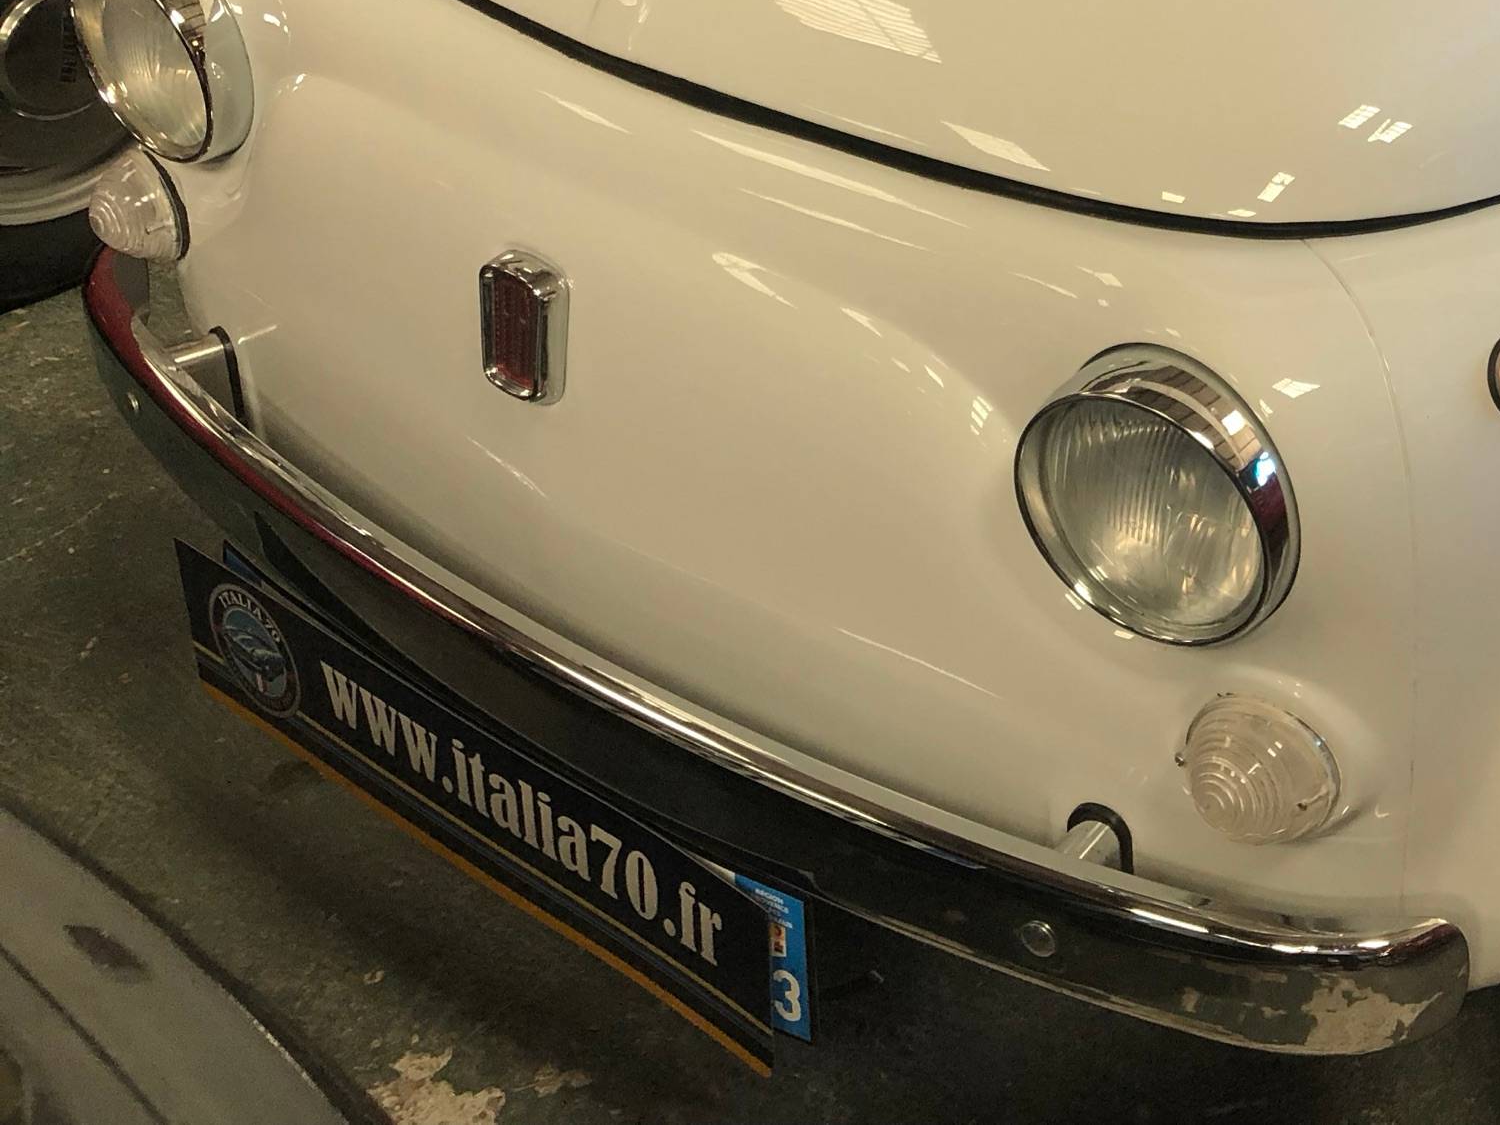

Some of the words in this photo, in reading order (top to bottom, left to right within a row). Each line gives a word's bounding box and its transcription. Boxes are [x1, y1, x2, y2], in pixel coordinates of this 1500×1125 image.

[218, 590, 264, 622] ITALIA
[263, 617, 282, 644] 70
[320, 659, 723, 967] www.italia70.fr
[772, 969, 802, 1022] 3
